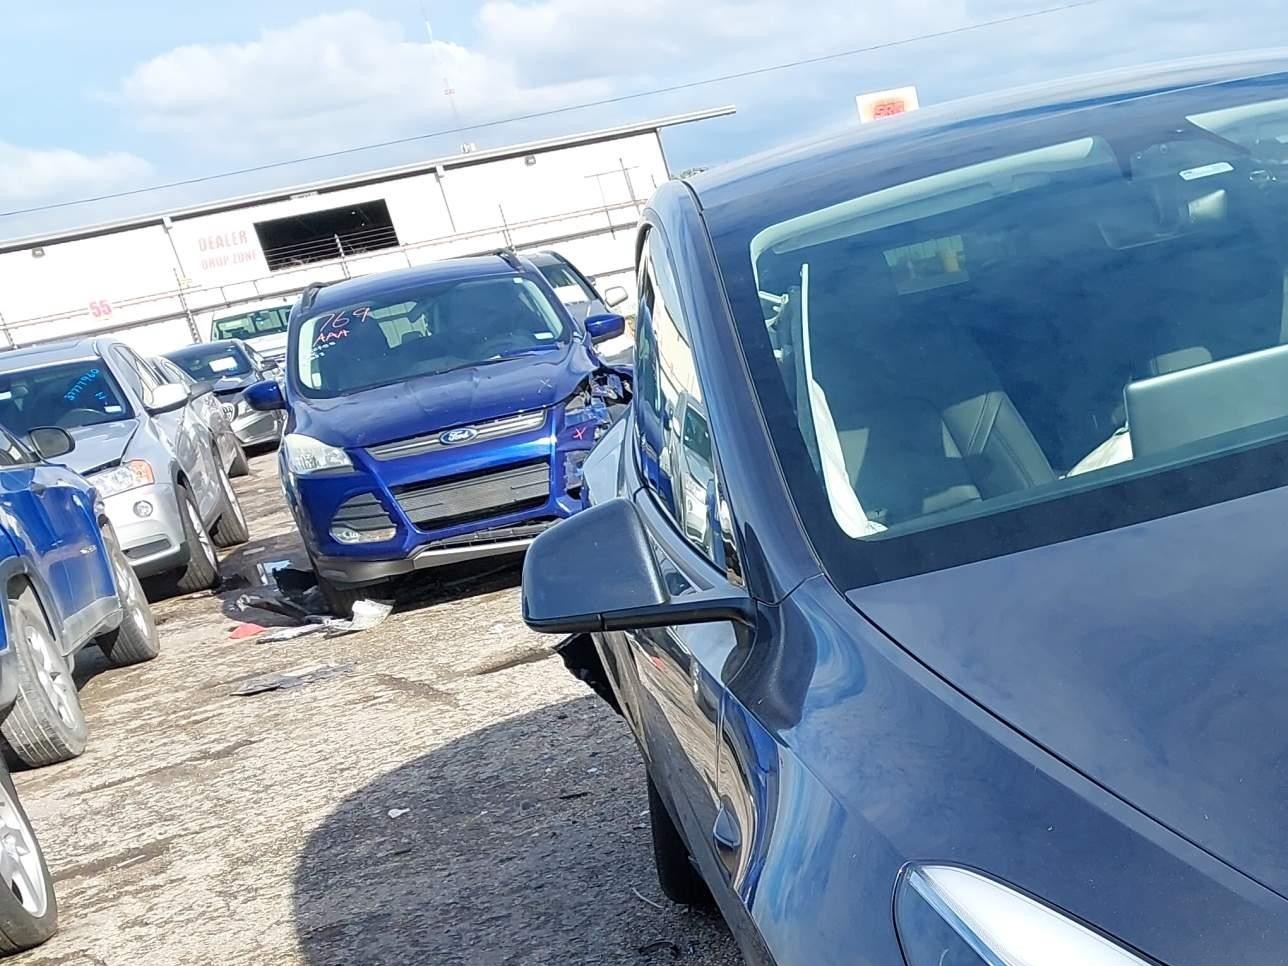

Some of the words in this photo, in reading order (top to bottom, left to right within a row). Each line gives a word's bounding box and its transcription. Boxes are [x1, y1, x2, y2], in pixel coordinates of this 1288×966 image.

[198, 230, 248, 253] DEALER
[89, 299, 112, 318] 55
[319, 307, 371, 332] 769
